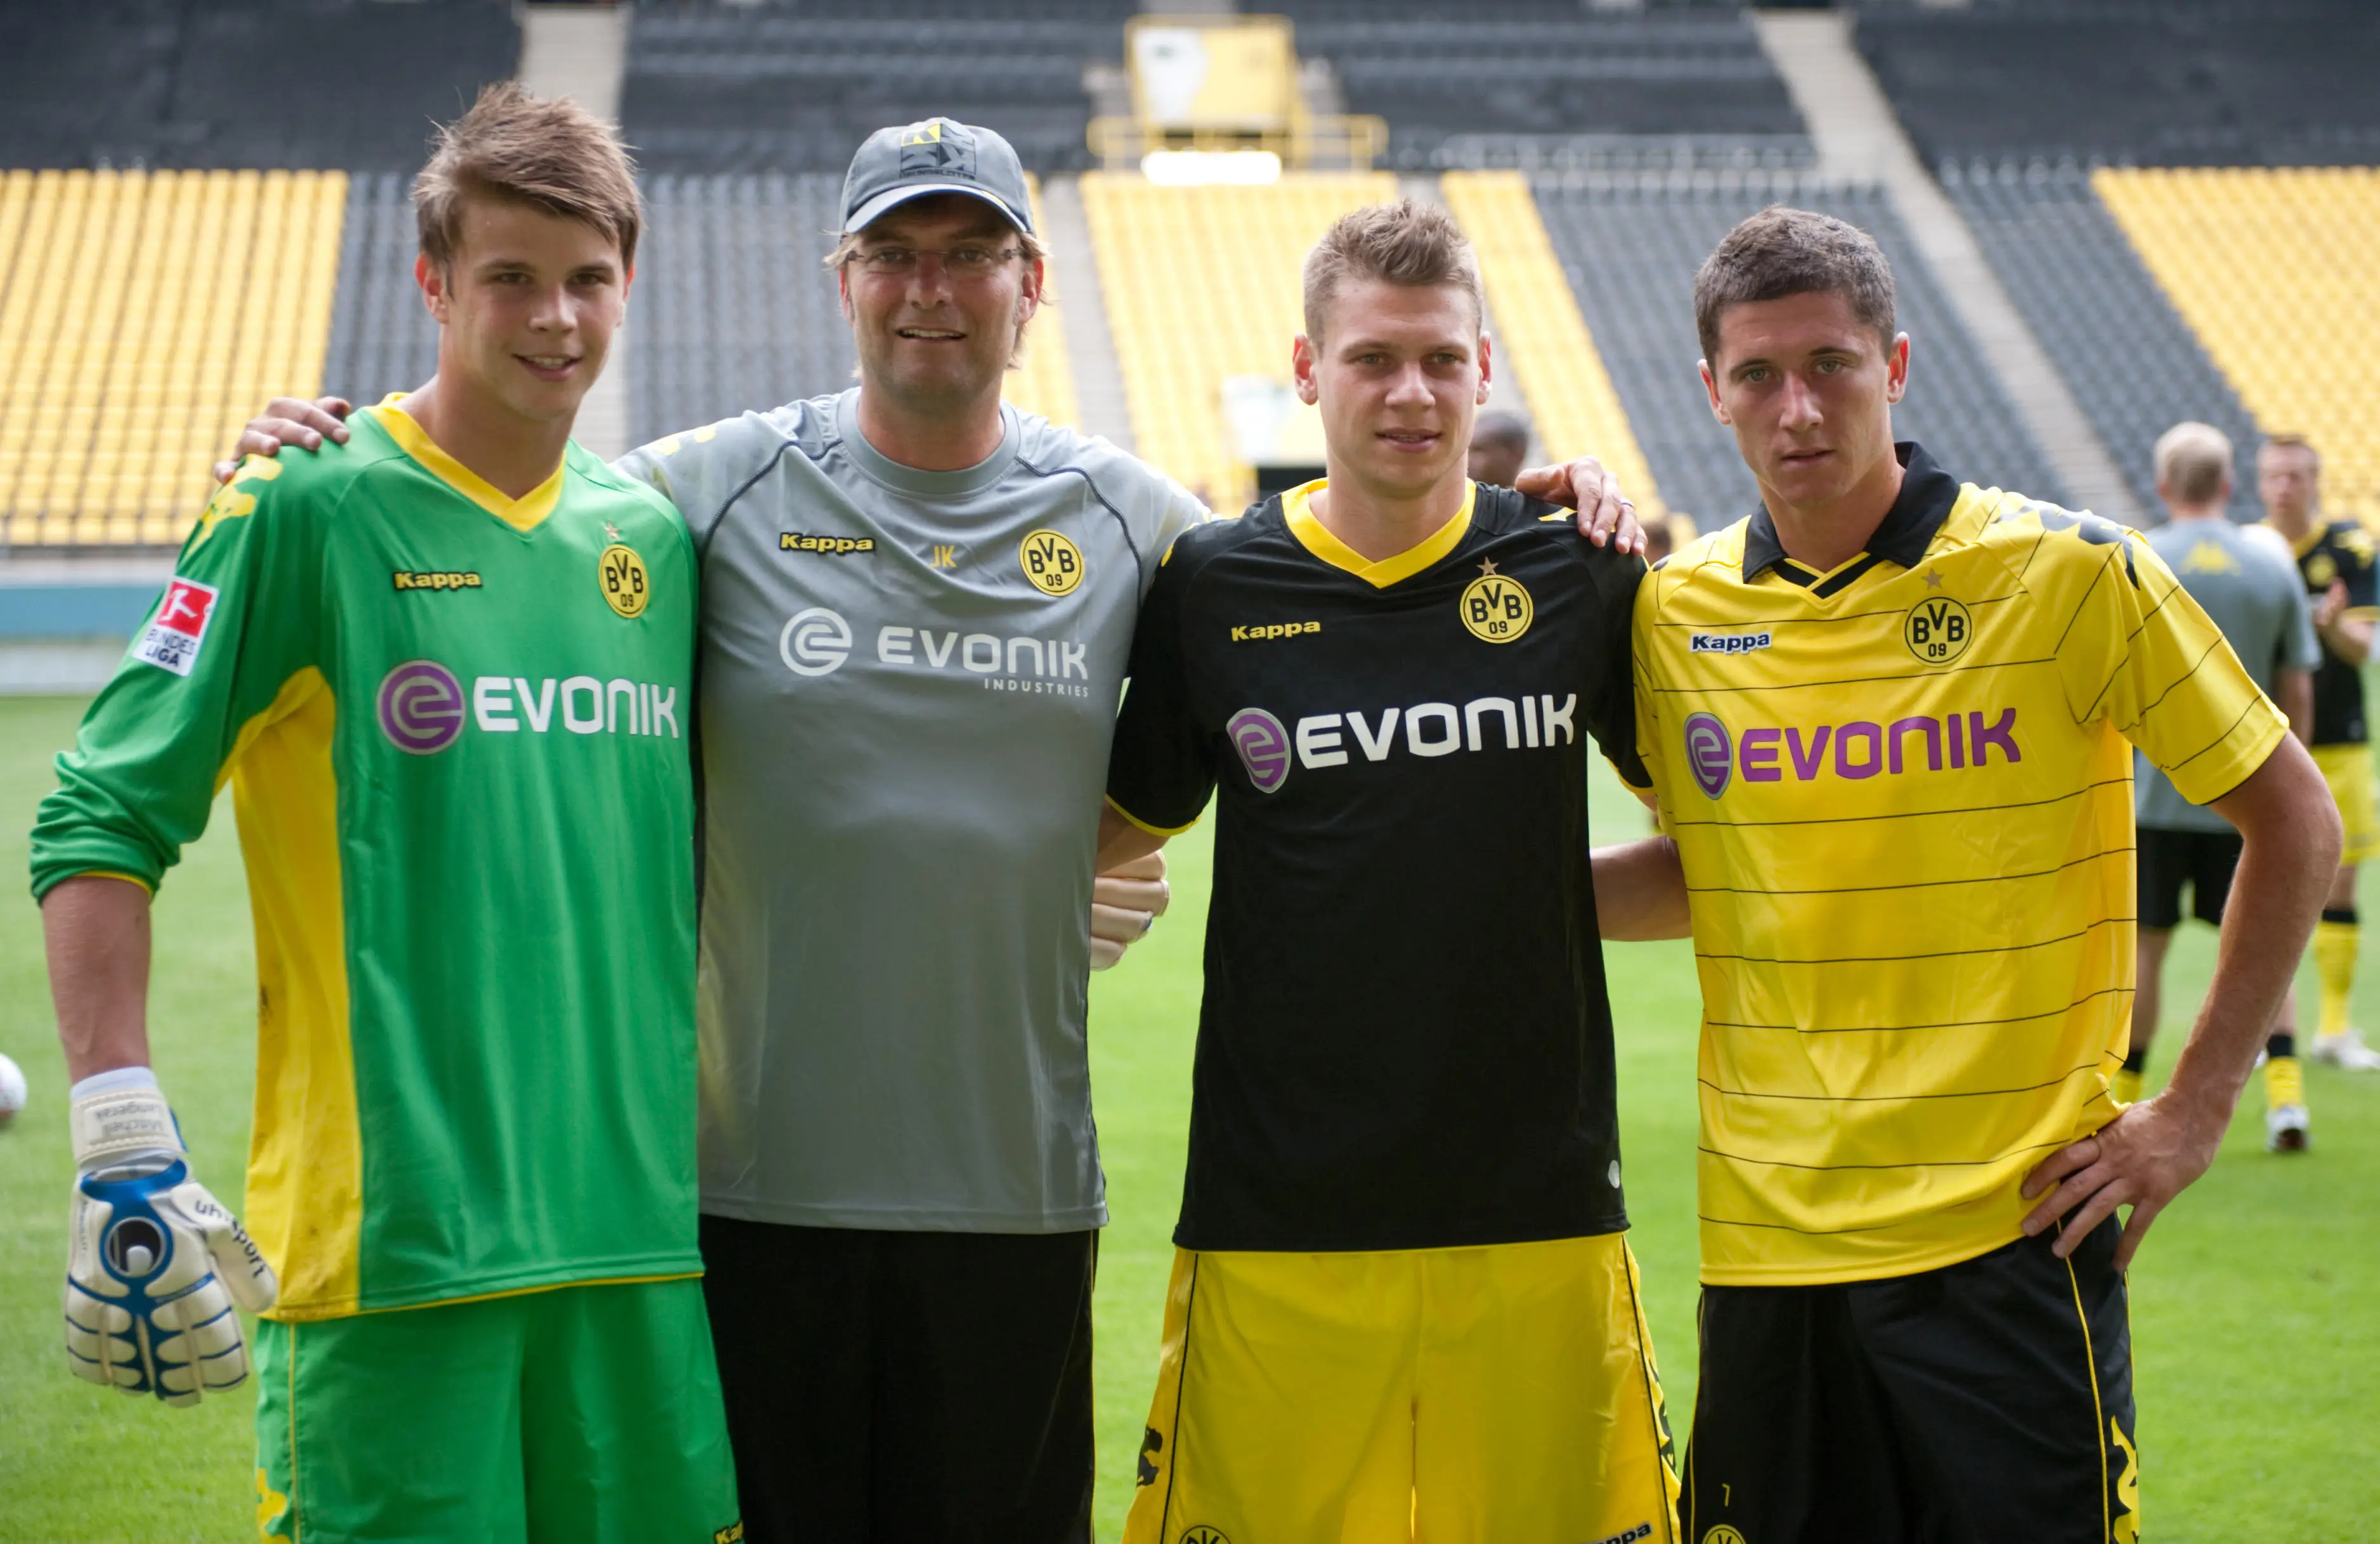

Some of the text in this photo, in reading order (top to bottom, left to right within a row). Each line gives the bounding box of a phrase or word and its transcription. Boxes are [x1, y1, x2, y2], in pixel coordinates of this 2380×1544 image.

[781, 534, 875, 554] Kappa
[929, 545, 956, 568] JK
[1027, 538, 1076, 574] BVB
[394, 572, 481, 590] Kappa
[606, 554, 644, 594] BVB
[1046, 573, 1063, 587] 09
[620, 594, 635, 607] 09
[1469, 583, 1523, 623] BVB
[1231, 621, 1321, 641] Kappa
[1489, 620, 1508, 635] 09
[1913, 603, 1965, 644] BVB
[878, 626, 1088, 679] EVONIK
[1692, 633, 1770, 652] Kappa
[1927, 642, 1947, 657] 09
[145, 644, 180, 666] LIGA
[984, 678, 1089, 697] INDUSTRIES
[474, 676, 679, 738] EVONIK
[1296, 694, 1577, 770] EVONIK
[1739, 708, 2021, 782] EVONIK
